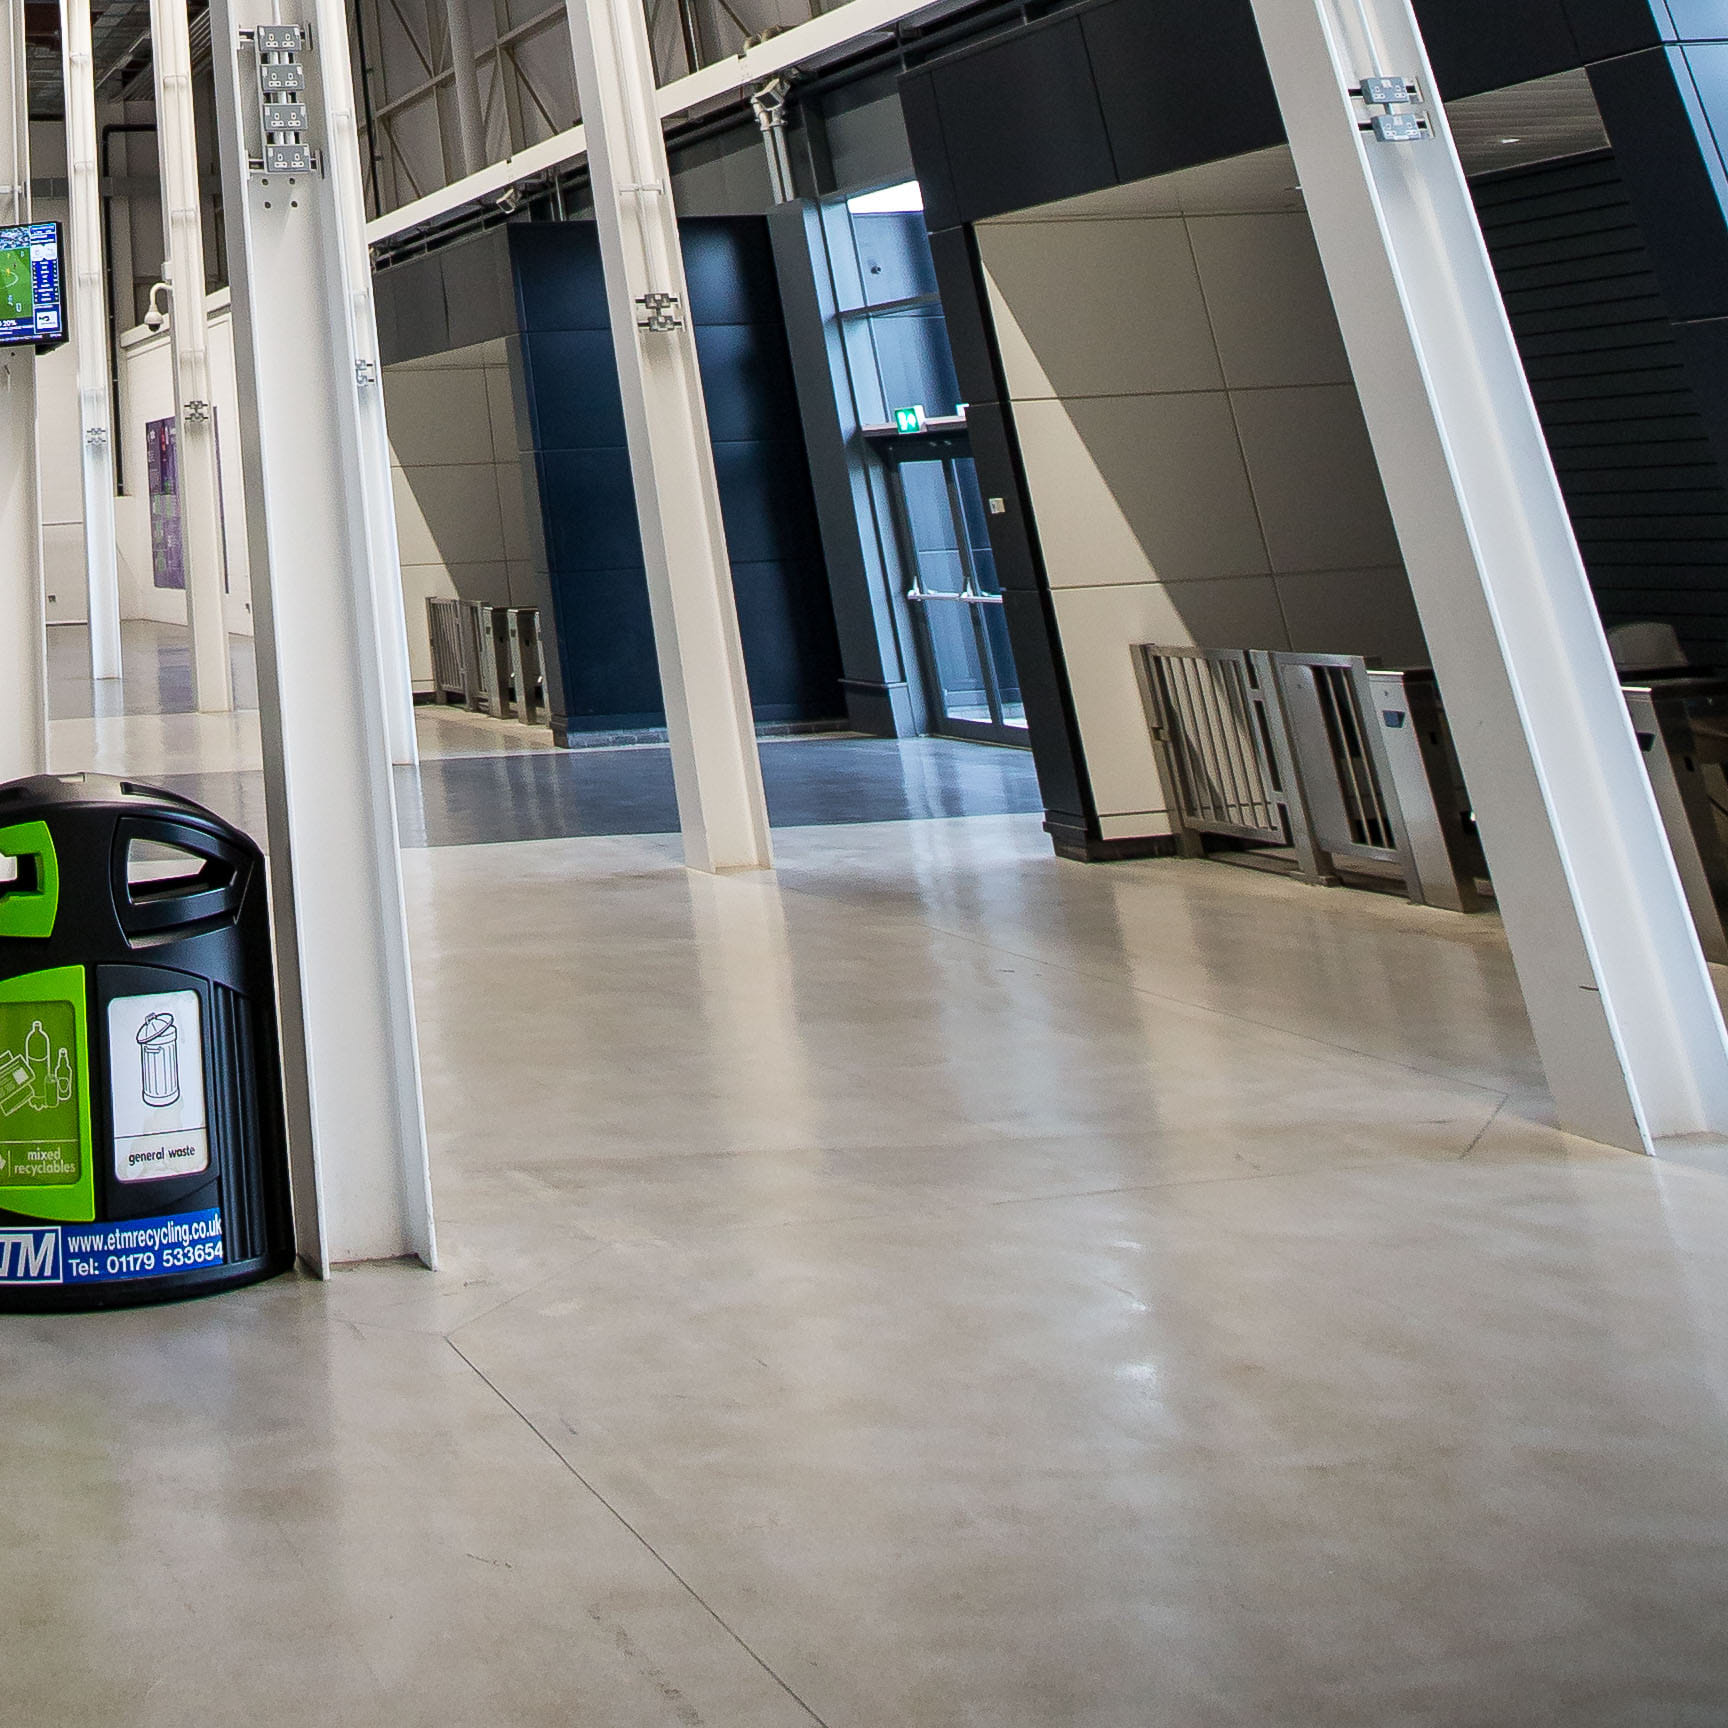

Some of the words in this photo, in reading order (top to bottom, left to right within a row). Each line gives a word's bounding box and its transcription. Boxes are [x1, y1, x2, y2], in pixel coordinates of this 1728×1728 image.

[27, 1148, 61, 1161] mixed
[128, 1150, 165, 1166] general
[168, 1146, 196, 1158] waste
[14, 1160, 76, 1177] recyclables
[67, 1213, 223, 1253] www.etmrecycling.co.uk
[68, 1258, 99, 1277] Tel:
[106, 1252, 155, 1274] 01179
[162, 1241, 223, 1267] 533654
